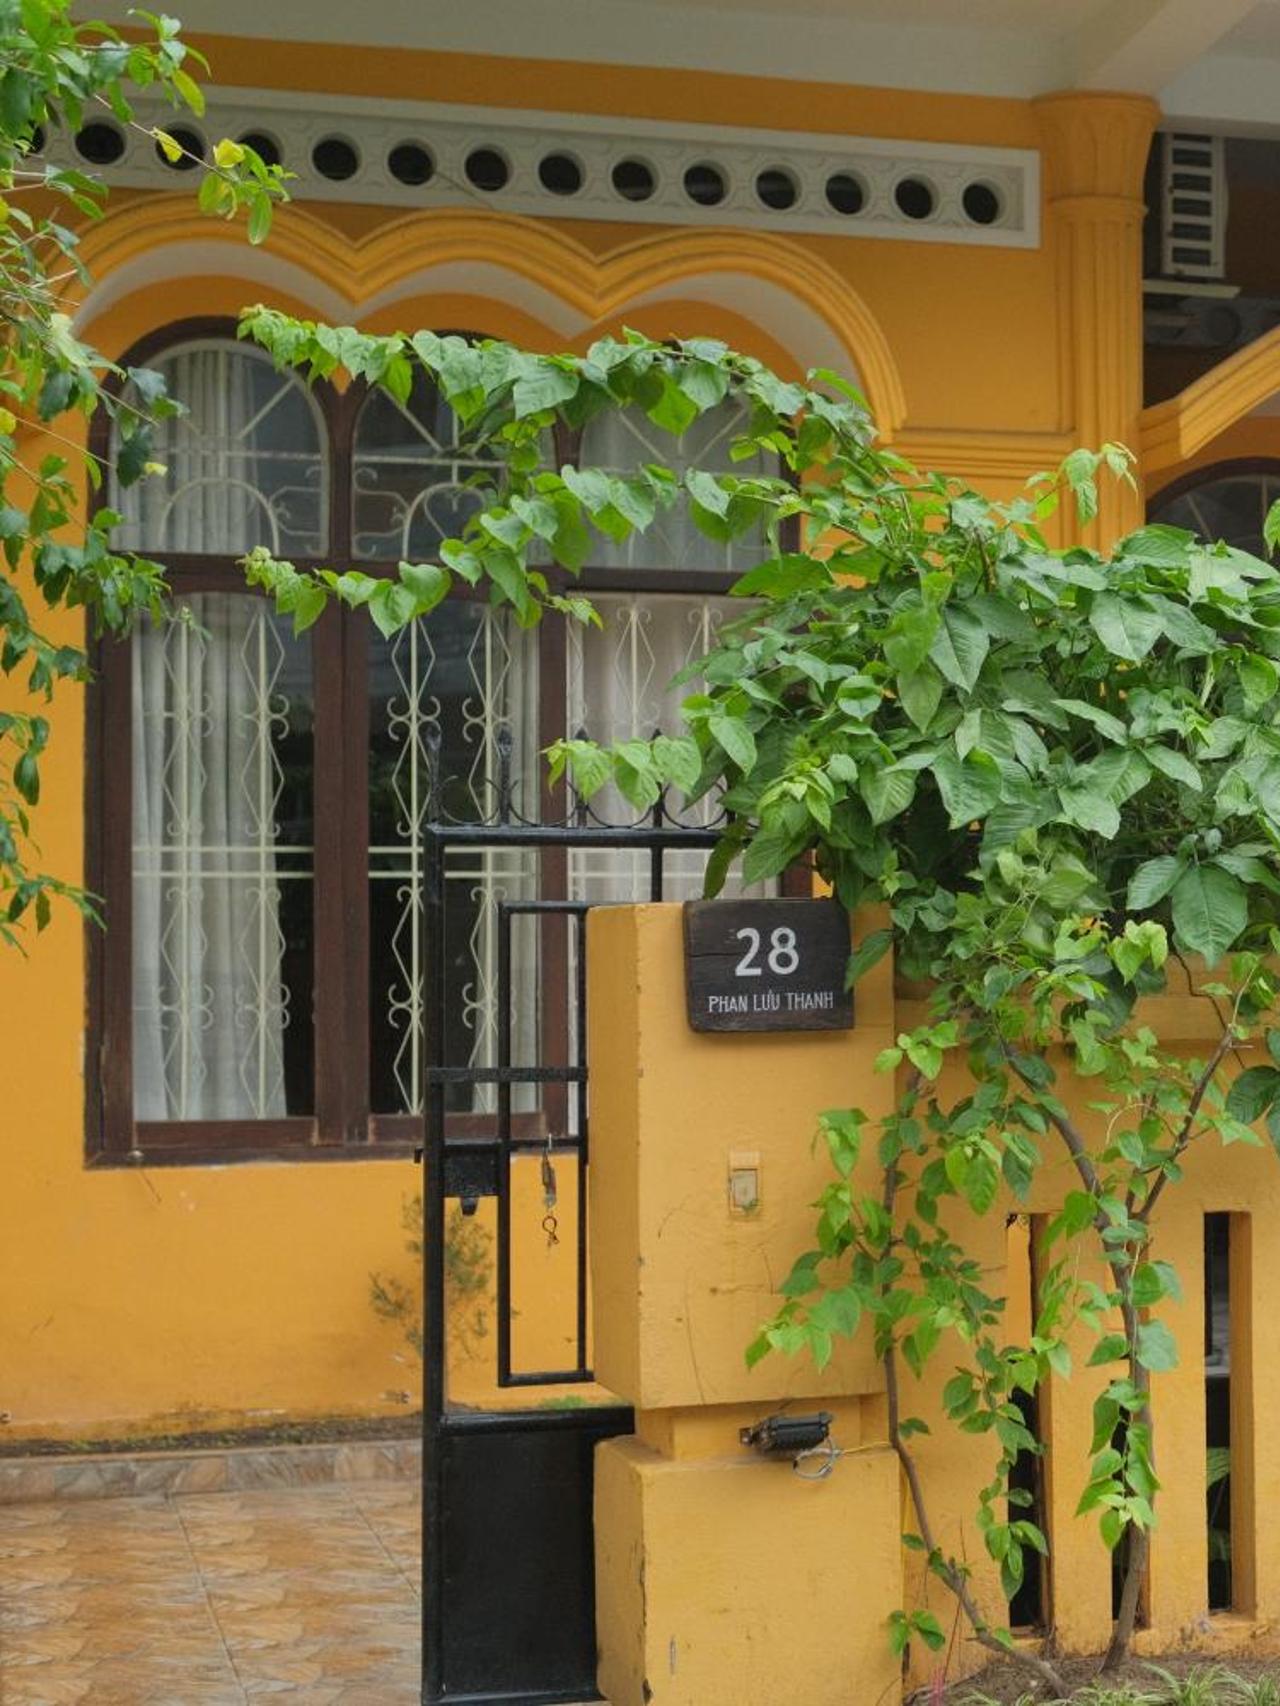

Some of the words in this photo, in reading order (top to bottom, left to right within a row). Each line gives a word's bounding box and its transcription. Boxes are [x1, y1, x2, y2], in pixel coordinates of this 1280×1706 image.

[734, 926, 800, 977] 28
[708, 995, 748, 1013] PHAN
[785, 991, 834, 1011] THANH
